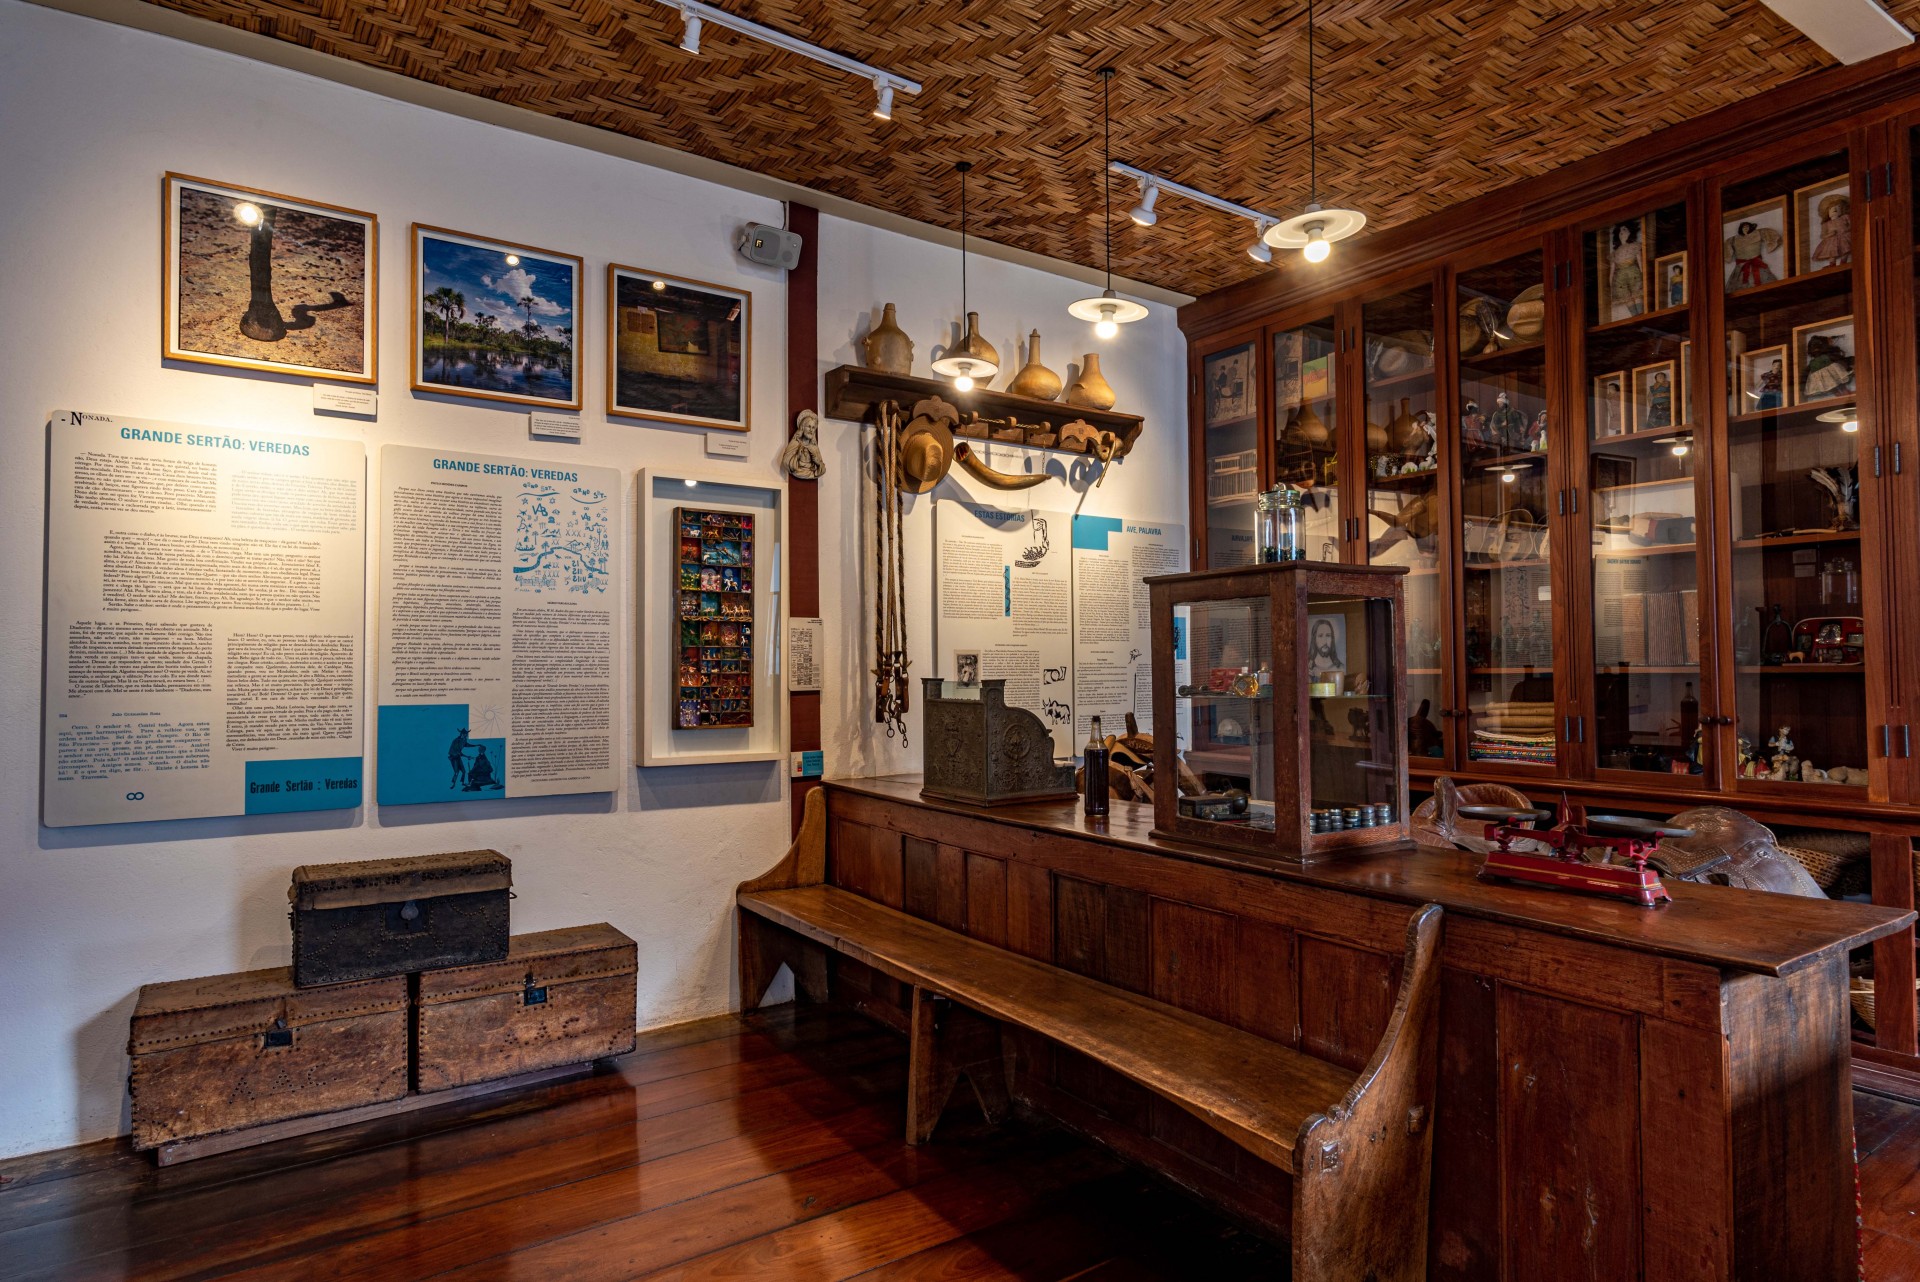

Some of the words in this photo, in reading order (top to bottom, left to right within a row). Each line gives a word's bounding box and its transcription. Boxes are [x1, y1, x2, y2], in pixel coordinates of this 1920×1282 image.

[121, 427, 182, 444] GRANDE
[187, 434, 245, 450] SERTÃO:
[249, 440, 310, 457] VEREDAS
[433, 458, 480, 473] GRANDE
[483, 463, 528, 478] SERTÃO:
[531, 468, 578, 482] VEREDAS
[975, 510, 993, 519] ESTAS
[995, 511, 1025, 523] ESTÓRIAS
[1138, 526, 1162, 536] PALAVRA
[250, 781, 280, 794] Grande
[286, 779, 313, 792] Sertão
[325, 778, 358, 790] Veredas
